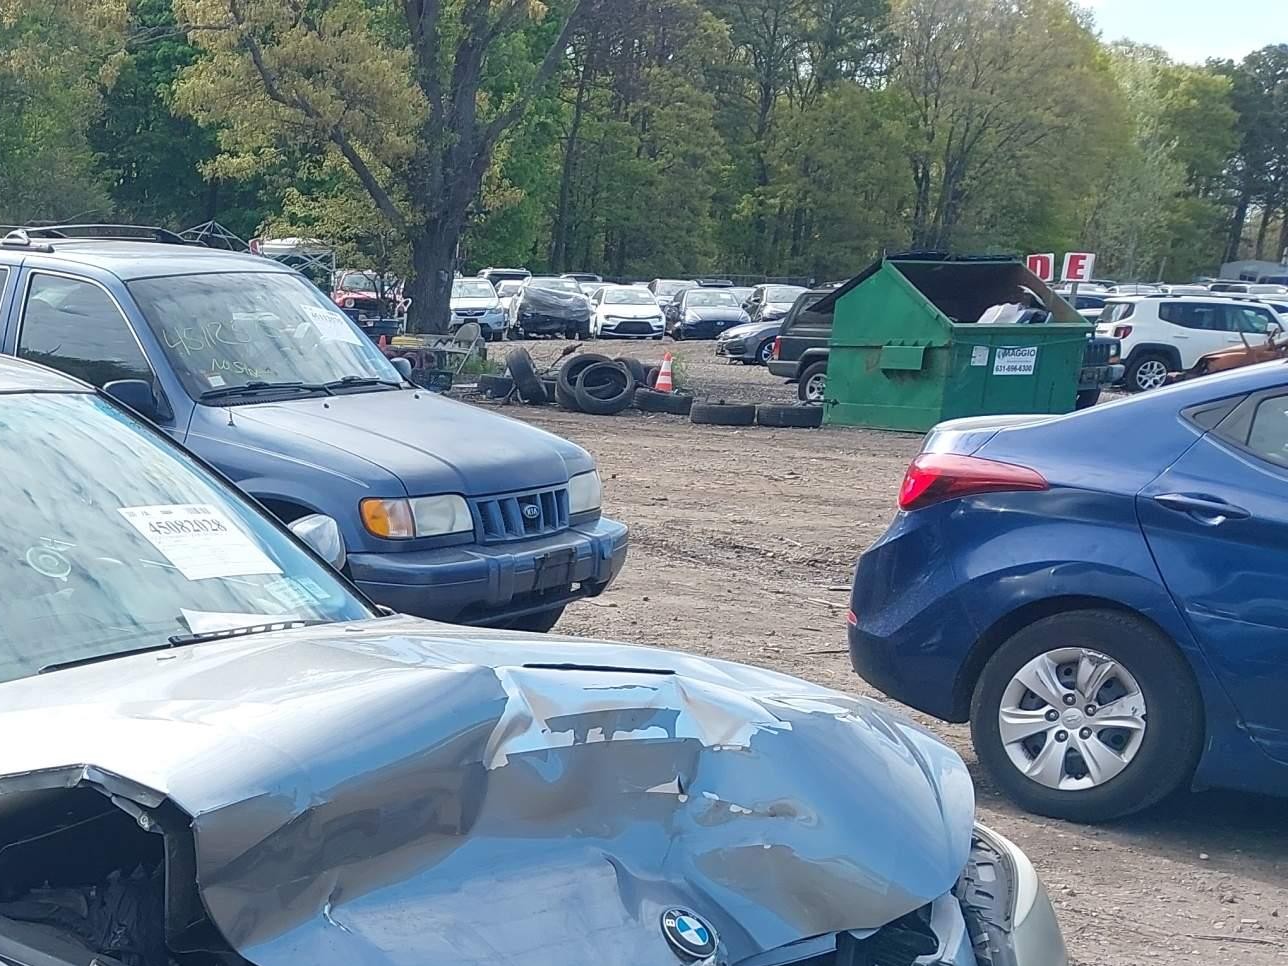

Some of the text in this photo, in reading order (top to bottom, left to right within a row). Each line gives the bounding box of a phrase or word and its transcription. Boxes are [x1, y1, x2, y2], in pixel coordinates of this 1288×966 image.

[1066, 254, 1087, 279] E
[1004, 349, 1036, 357] MAGGIO
[149, 519, 228, 535] 45082028
